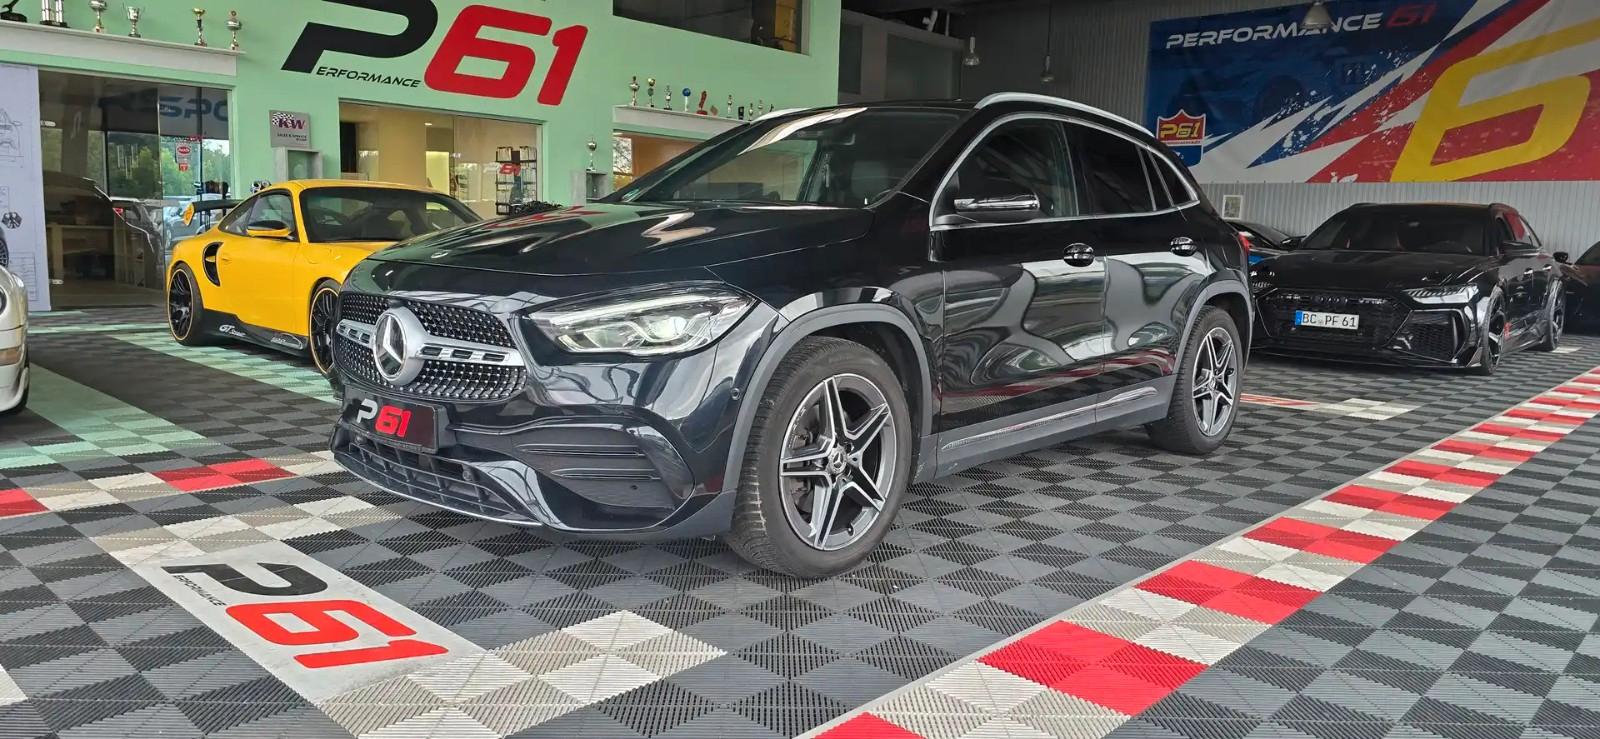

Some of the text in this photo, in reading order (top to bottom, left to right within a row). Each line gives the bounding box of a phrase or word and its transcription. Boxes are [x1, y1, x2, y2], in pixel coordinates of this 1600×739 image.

[1160, 121, 1202, 139] P61
[1302, 313, 1356, 328] BC PF 61
[356, 398, 412, 438] P61
[161, 562, 449, 669] P61
